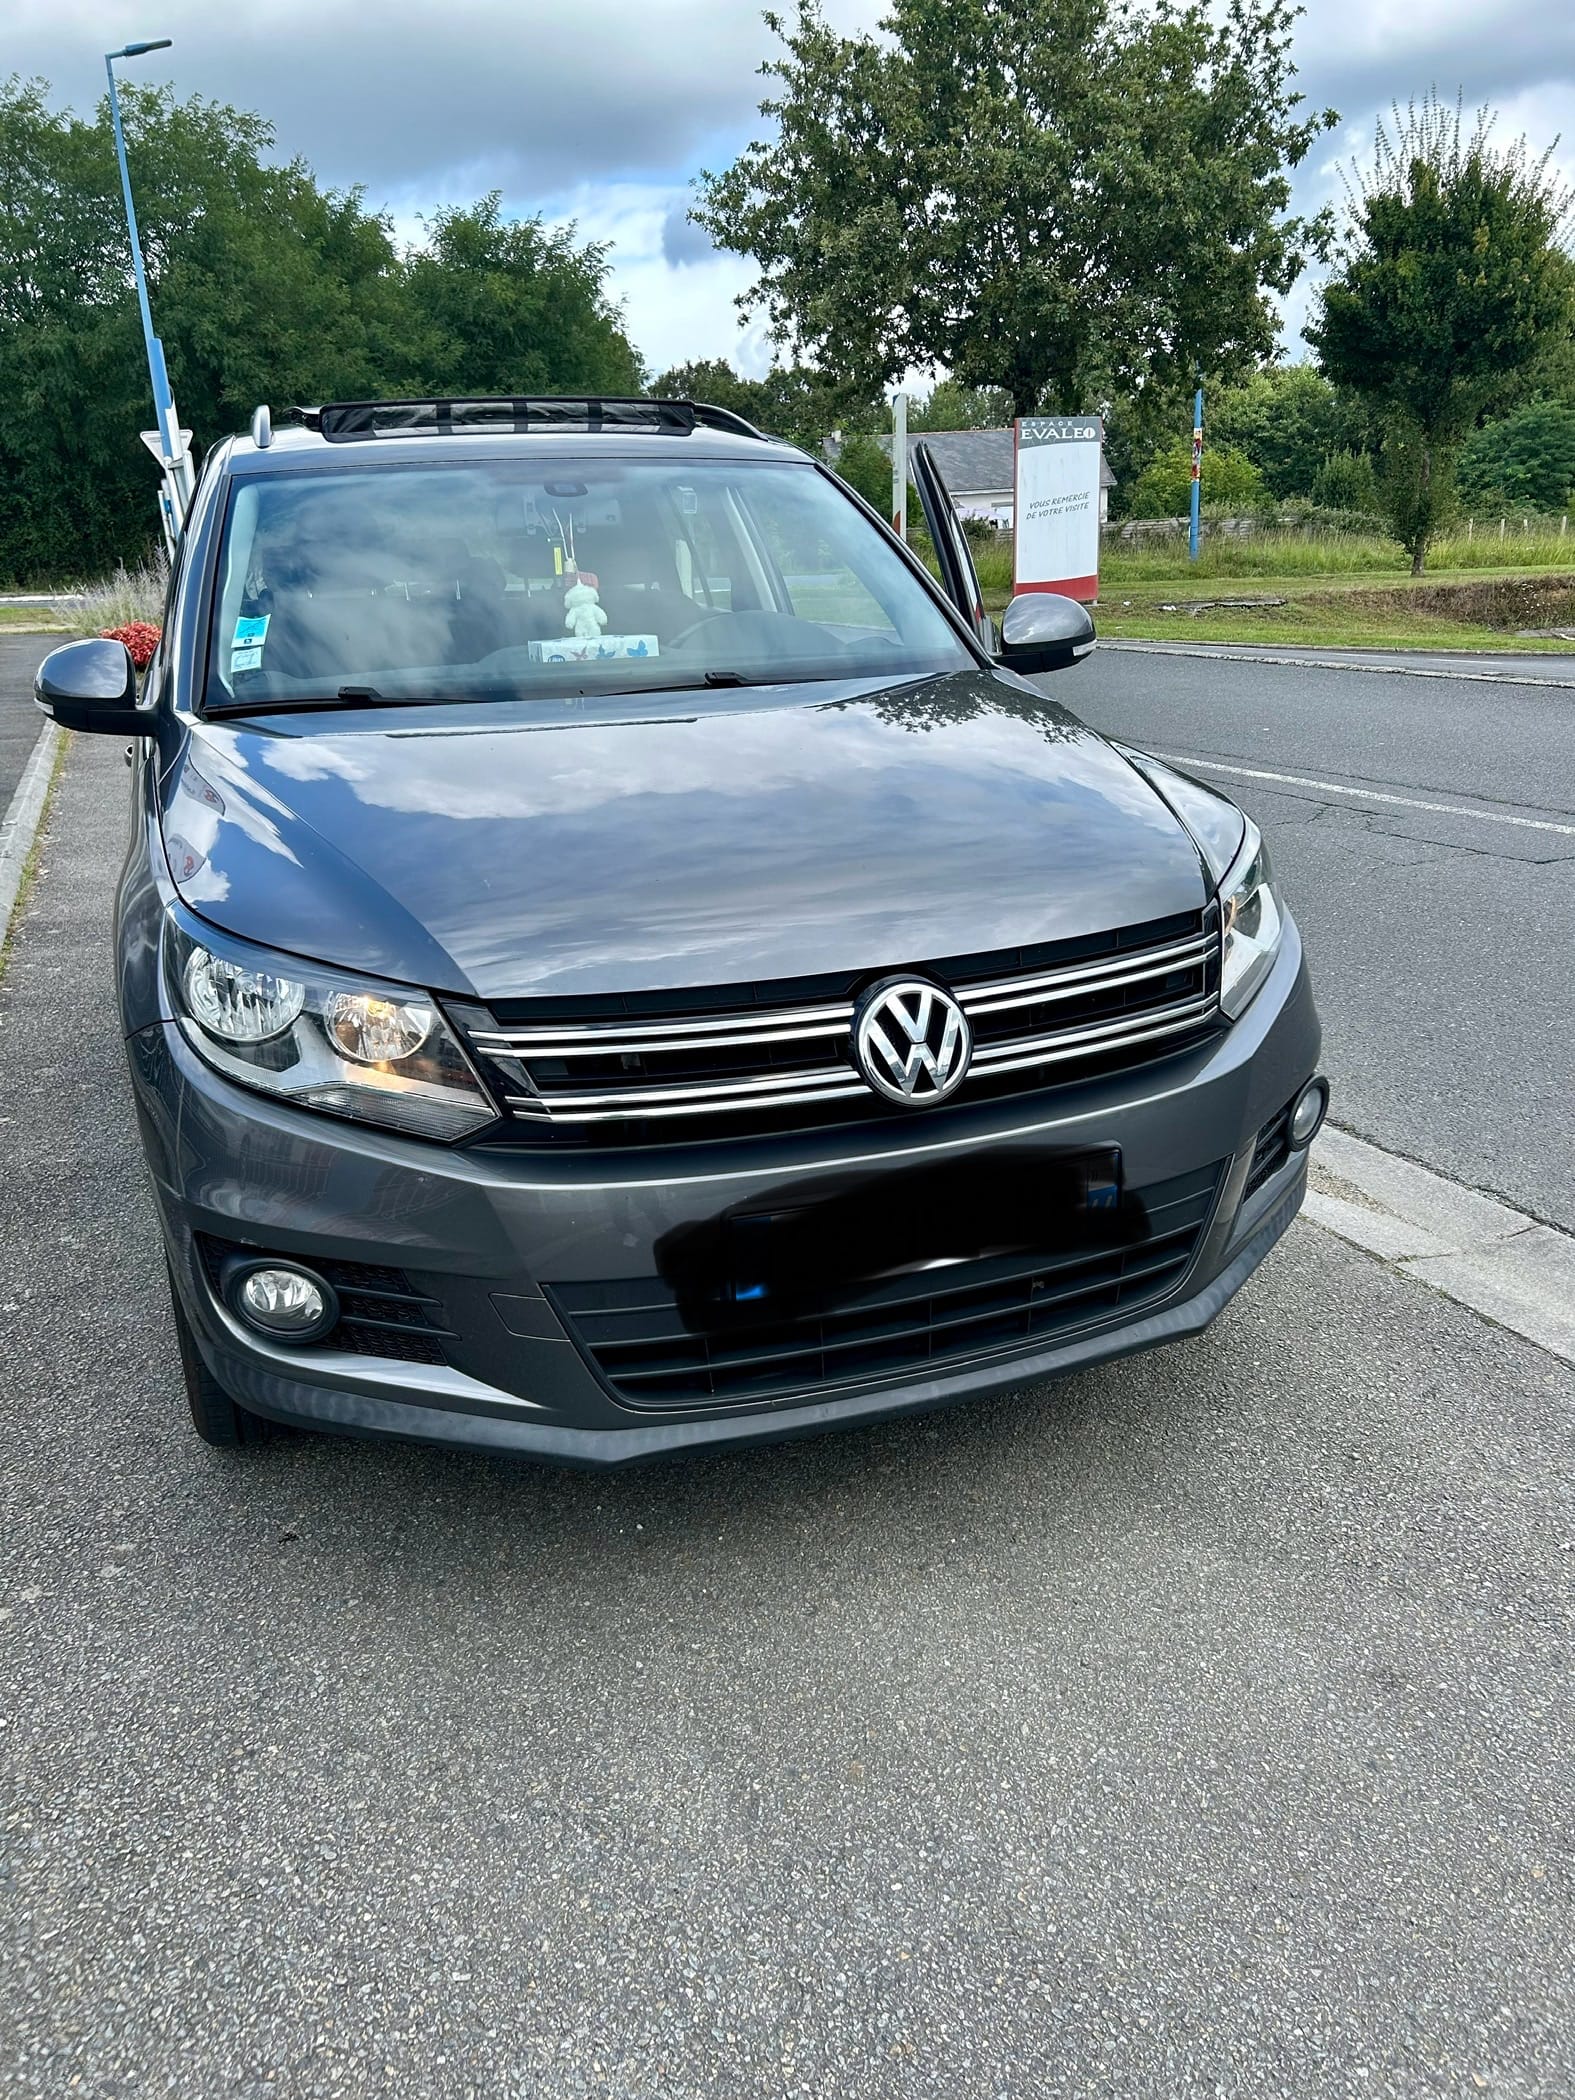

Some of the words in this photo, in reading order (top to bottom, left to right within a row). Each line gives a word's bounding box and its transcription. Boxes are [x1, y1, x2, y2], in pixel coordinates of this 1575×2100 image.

[1021, 420, 1074, 428] ESPACE
[1029, 498, 1051, 510] VOUS
[1051, 491, 1090, 506] REMERCIE
[1026, 510, 1037, 520] DE
[1038, 505, 1064, 518] VOTRE
[1064, 501, 1090, 514] VISITE
[862, 983, 966, 1101] VW
